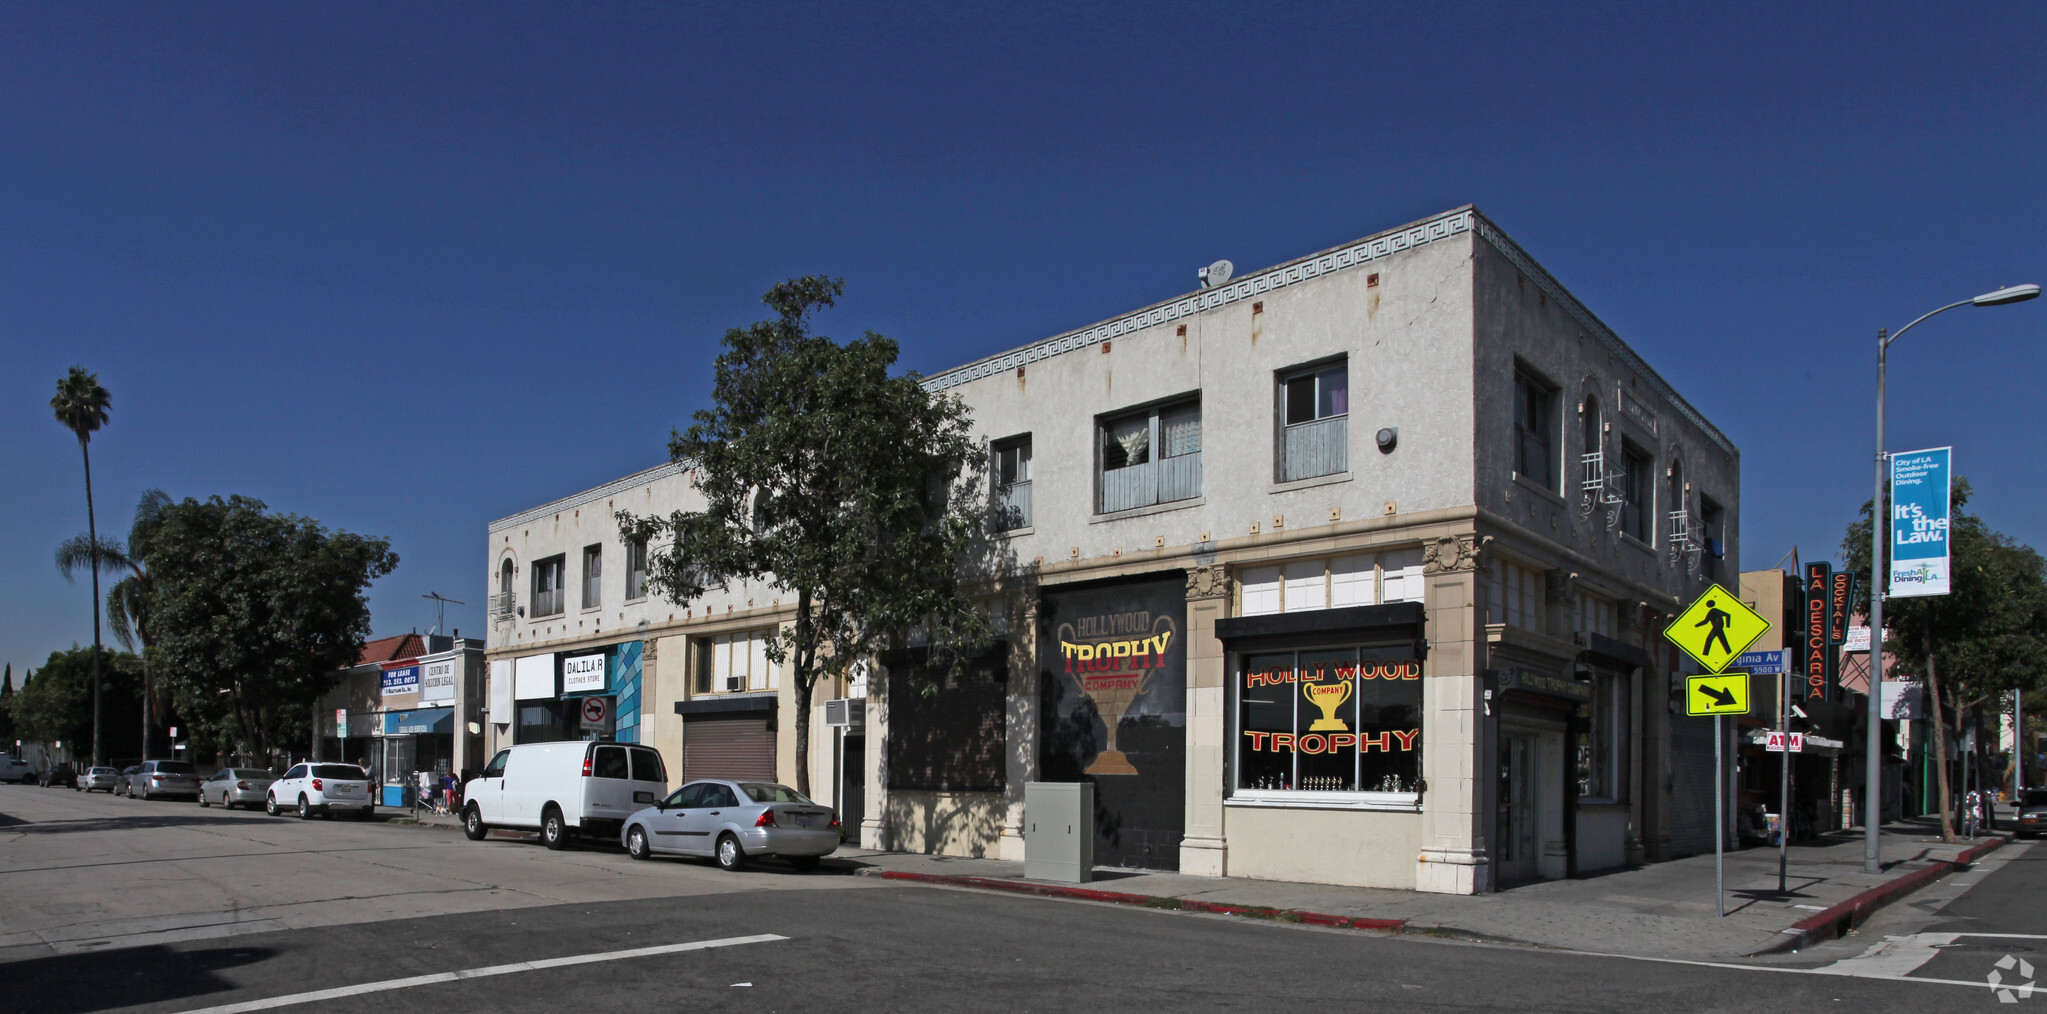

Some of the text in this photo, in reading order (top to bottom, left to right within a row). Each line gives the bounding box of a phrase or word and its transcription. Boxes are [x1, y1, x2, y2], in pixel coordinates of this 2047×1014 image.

[1896, 463, 1939, 473] Smoke-free
[1896, 470, 1928, 479] Outdoor
[1896, 478, 1923, 486] Dining.
[1912, 515, 1947, 531] the
[1897, 530, 1944, 545] Law.
[1810, 566, 1827, 591] LA
[1894, 575, 1923, 583] Dining
[1831, 574, 1847, 640] COCKTAILS
[1077, 611, 1150, 637] HOLLYWOOD
[1061, 631, 1171, 673] TROPHY
[1808, 599, 1826, 699] DESCARGA
[1736, 653, 1779, 665] ginia Av
[397, 669, 411, 677] LEASE
[568, 674, 600, 685] CLOTHES STORE
[1085, 680, 1138, 691] COMPANY
[1313, 685, 1344, 695] COMPANY
[1244, 729, 1420, 754] TROPHY
[1769, 735, 1798, 746] ATM
